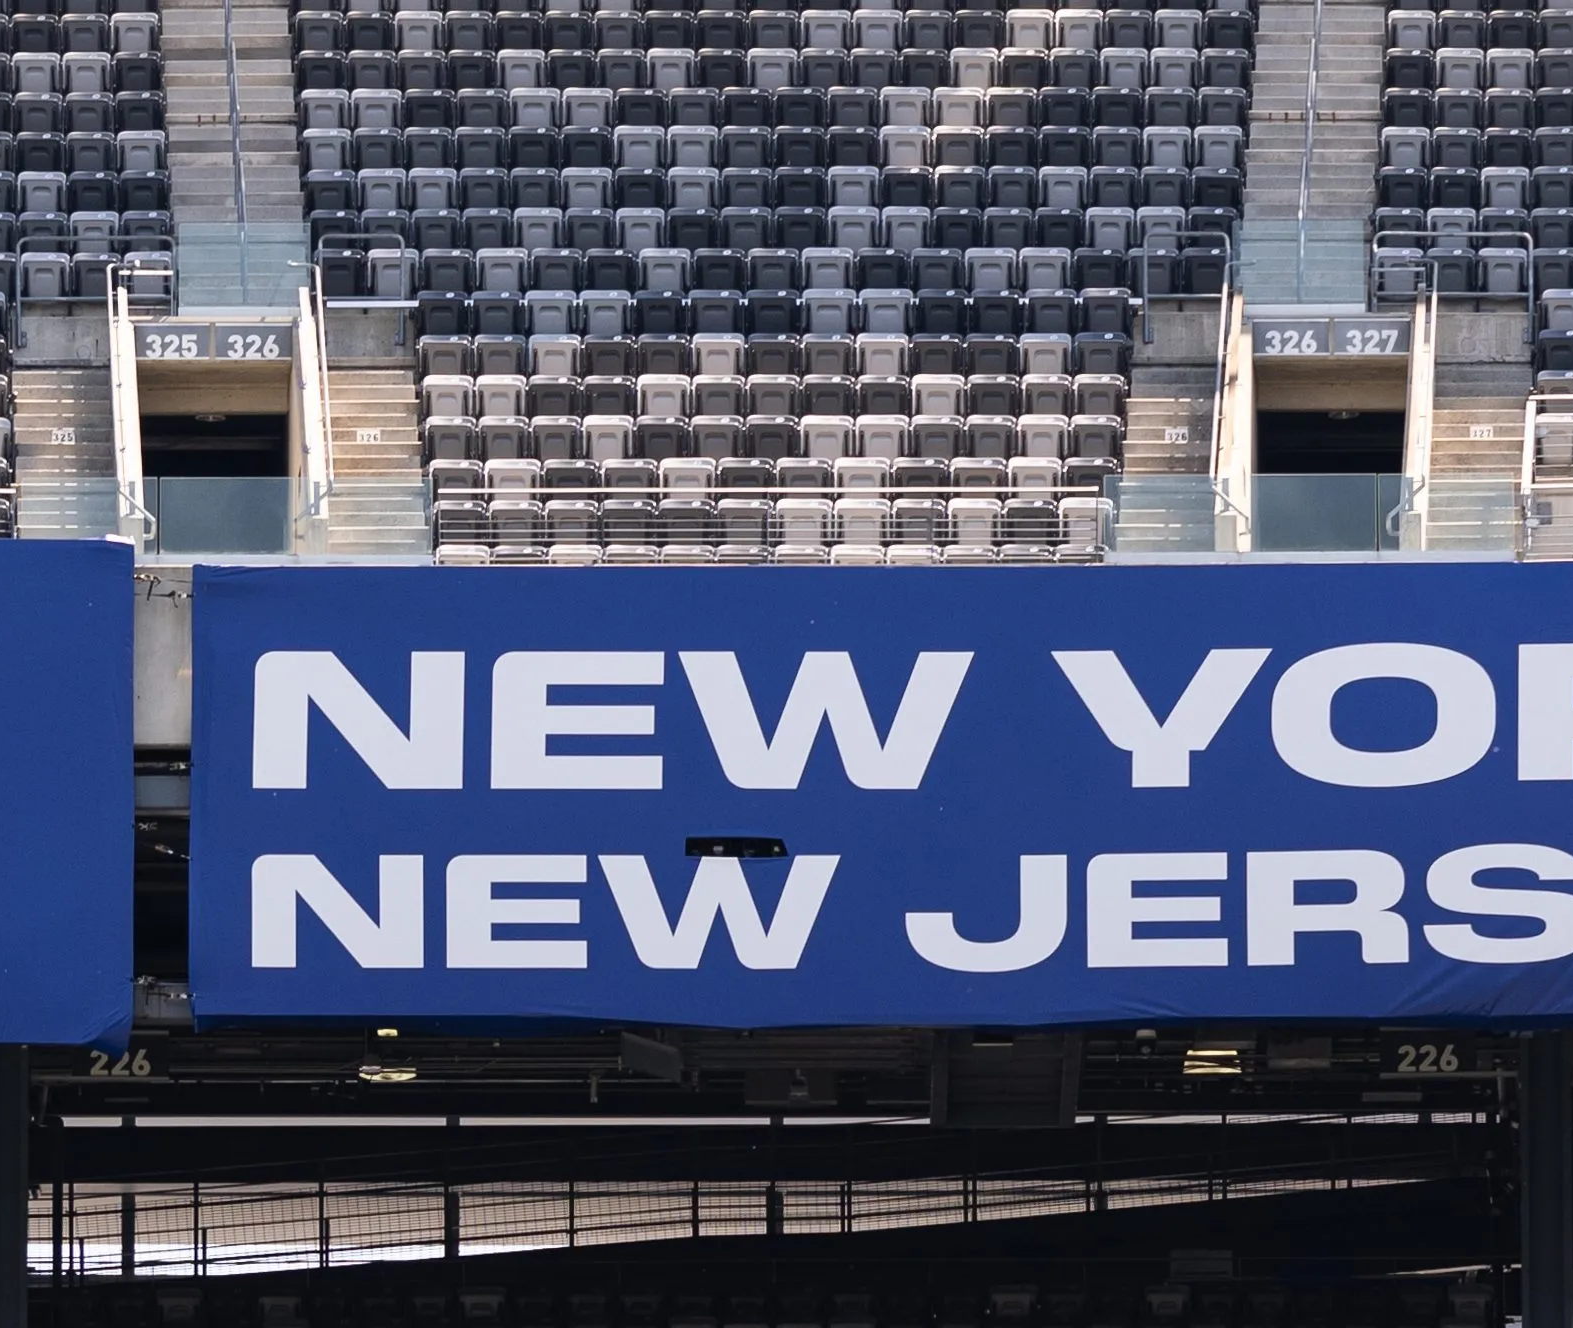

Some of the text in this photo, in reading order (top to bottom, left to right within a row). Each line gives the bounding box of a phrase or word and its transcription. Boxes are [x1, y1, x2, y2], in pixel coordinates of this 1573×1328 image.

[145, 333, 198, 359] 325
[227, 333, 279, 359] 326
[1264, 328, 1317, 355] 326
[1345, 327, 1398, 355] 327
[53, 432, 73, 442] 325
[359, 433, 379, 442] 326
[1167, 433, 1188, 443] 326
[1472, 428, 1491, 438] 327
[253, 651, 974, 789] NEW
[252, 855, 840, 969] NEW
[90, 1049, 151, 1076] 226
[1397, 1044, 1458, 1072] 226
